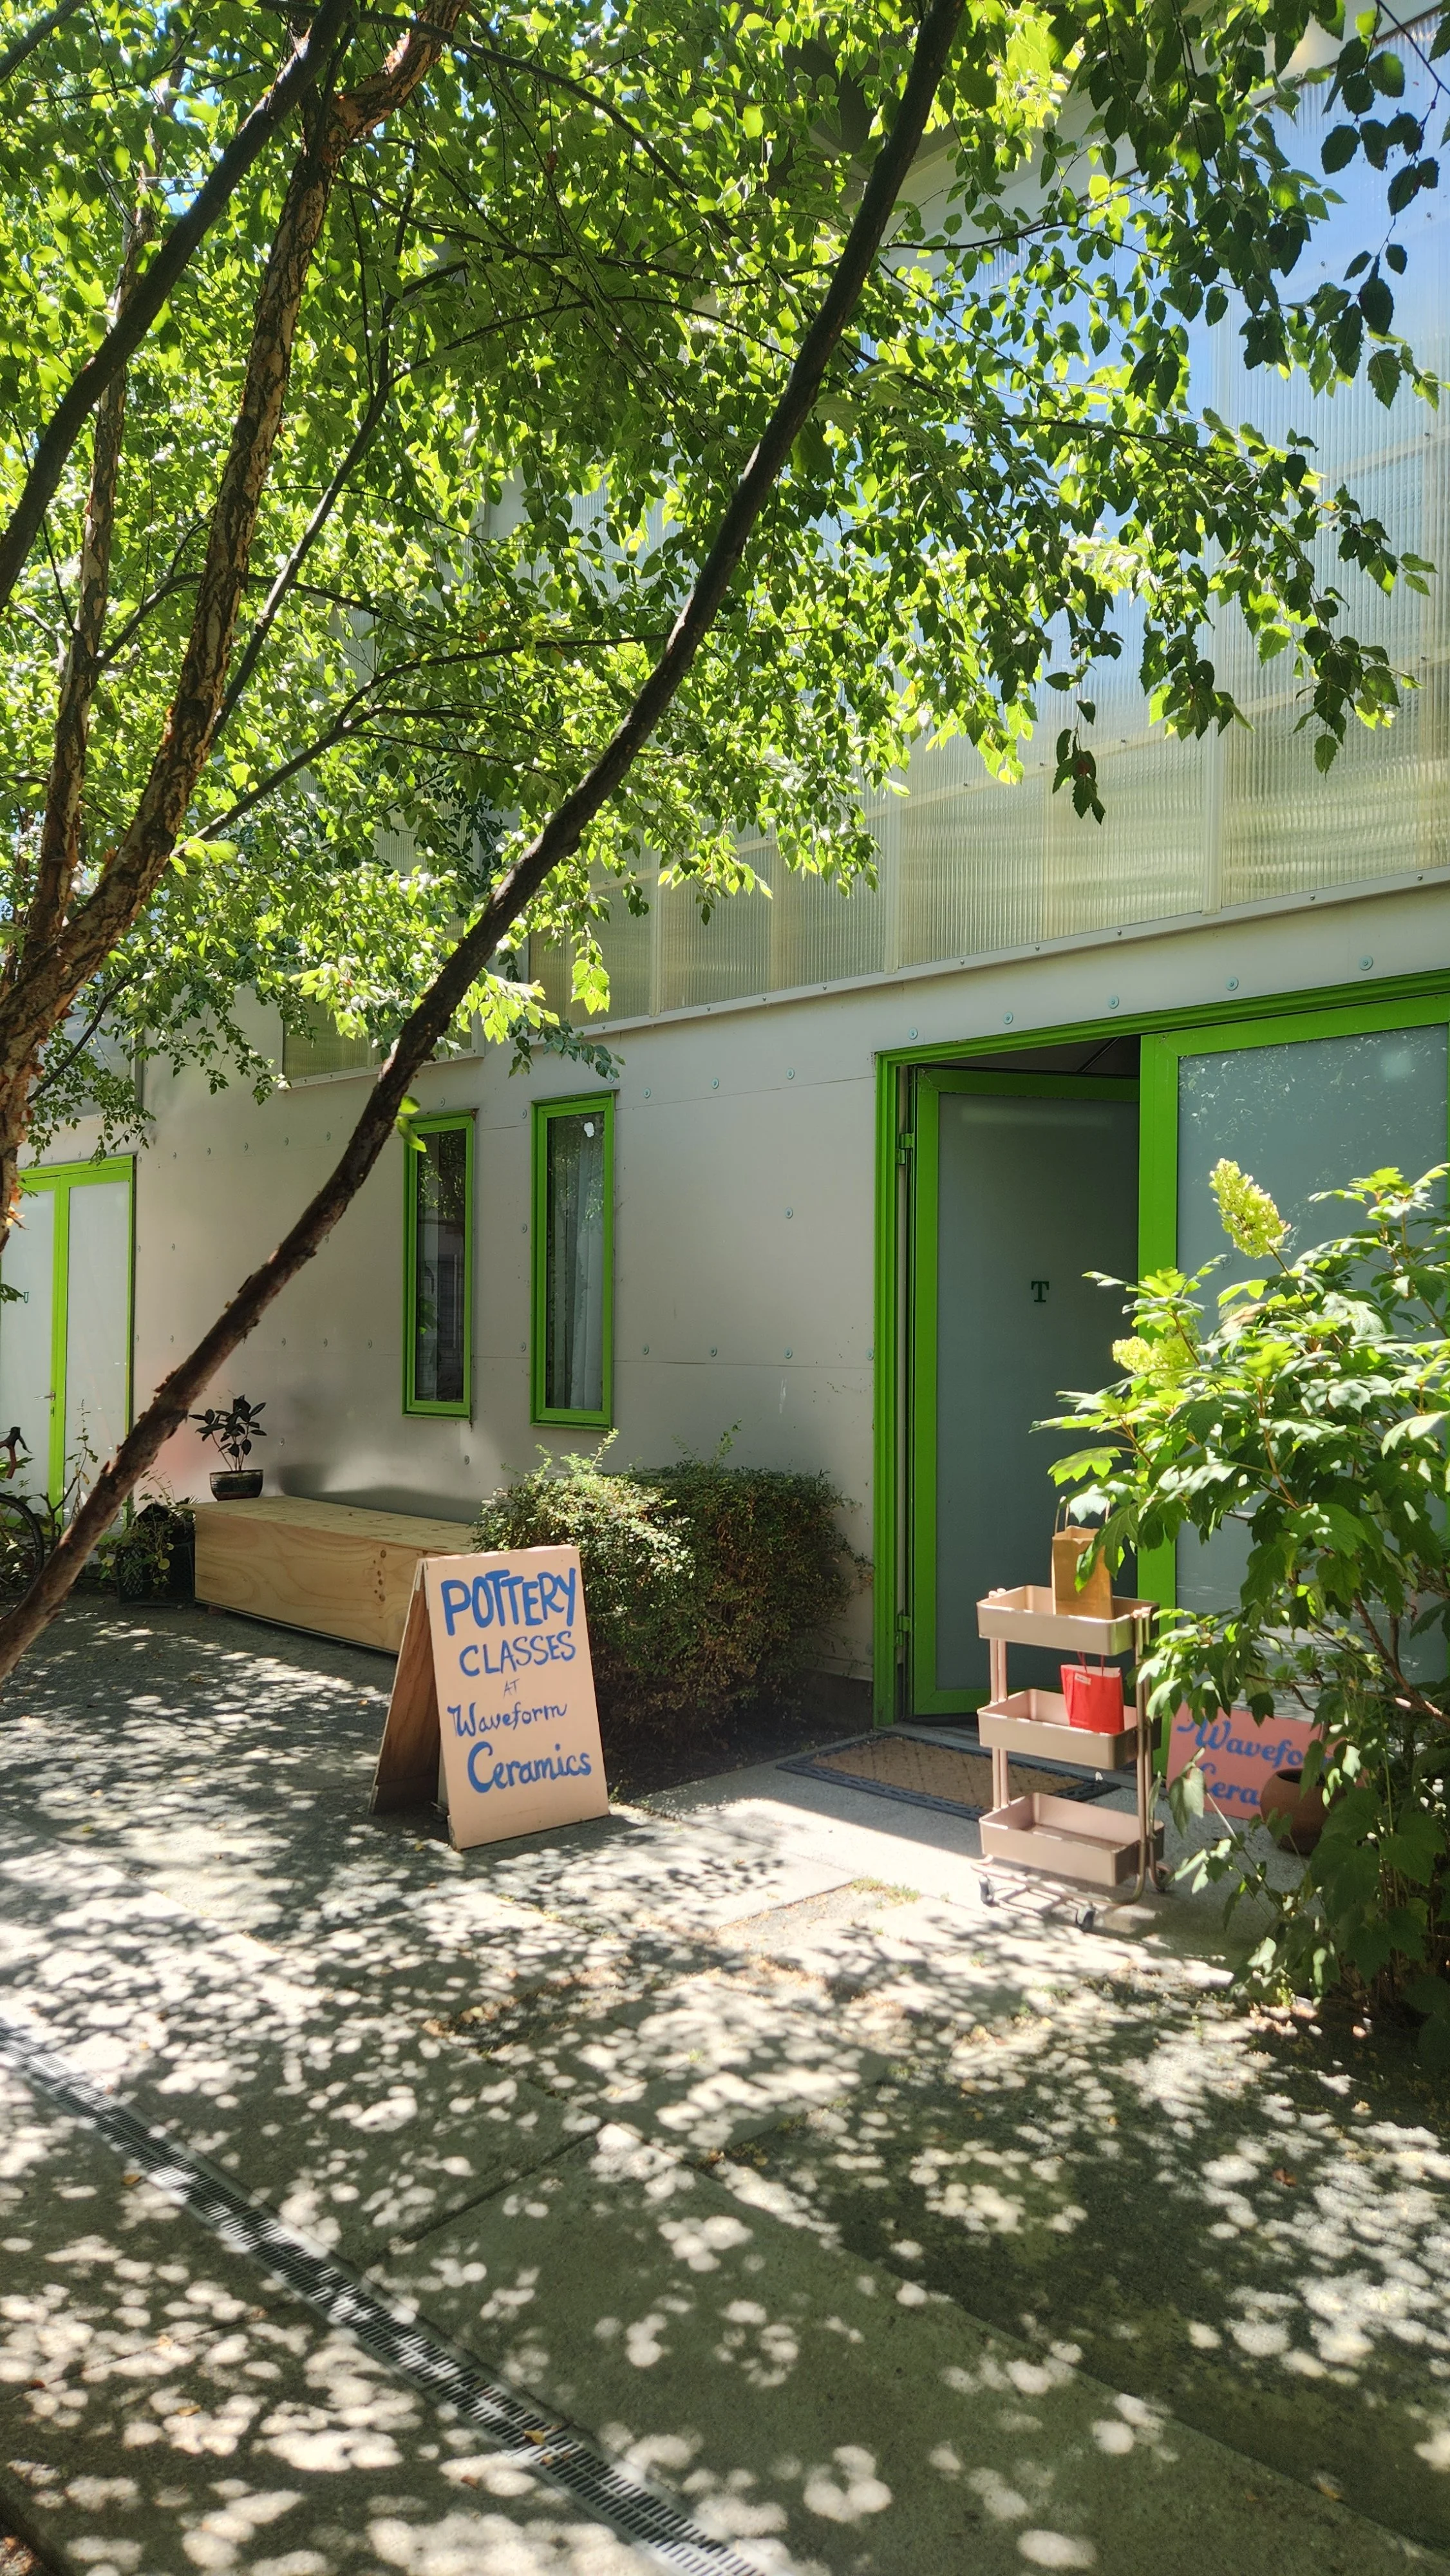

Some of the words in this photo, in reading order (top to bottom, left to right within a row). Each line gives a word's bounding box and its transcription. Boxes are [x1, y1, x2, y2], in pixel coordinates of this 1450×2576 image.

[1031, 1281, 1050, 1302] T
[440, 1567, 576, 1636] POTTERY
[459, 1631, 576, 1677] CLASSES
[503, 1678, 520, 1700] AT
[447, 1702, 568, 1738] Waveform
[1176, 1717, 1334, 1769] Wavefo
[467, 1741, 592, 1794] Ceramics
